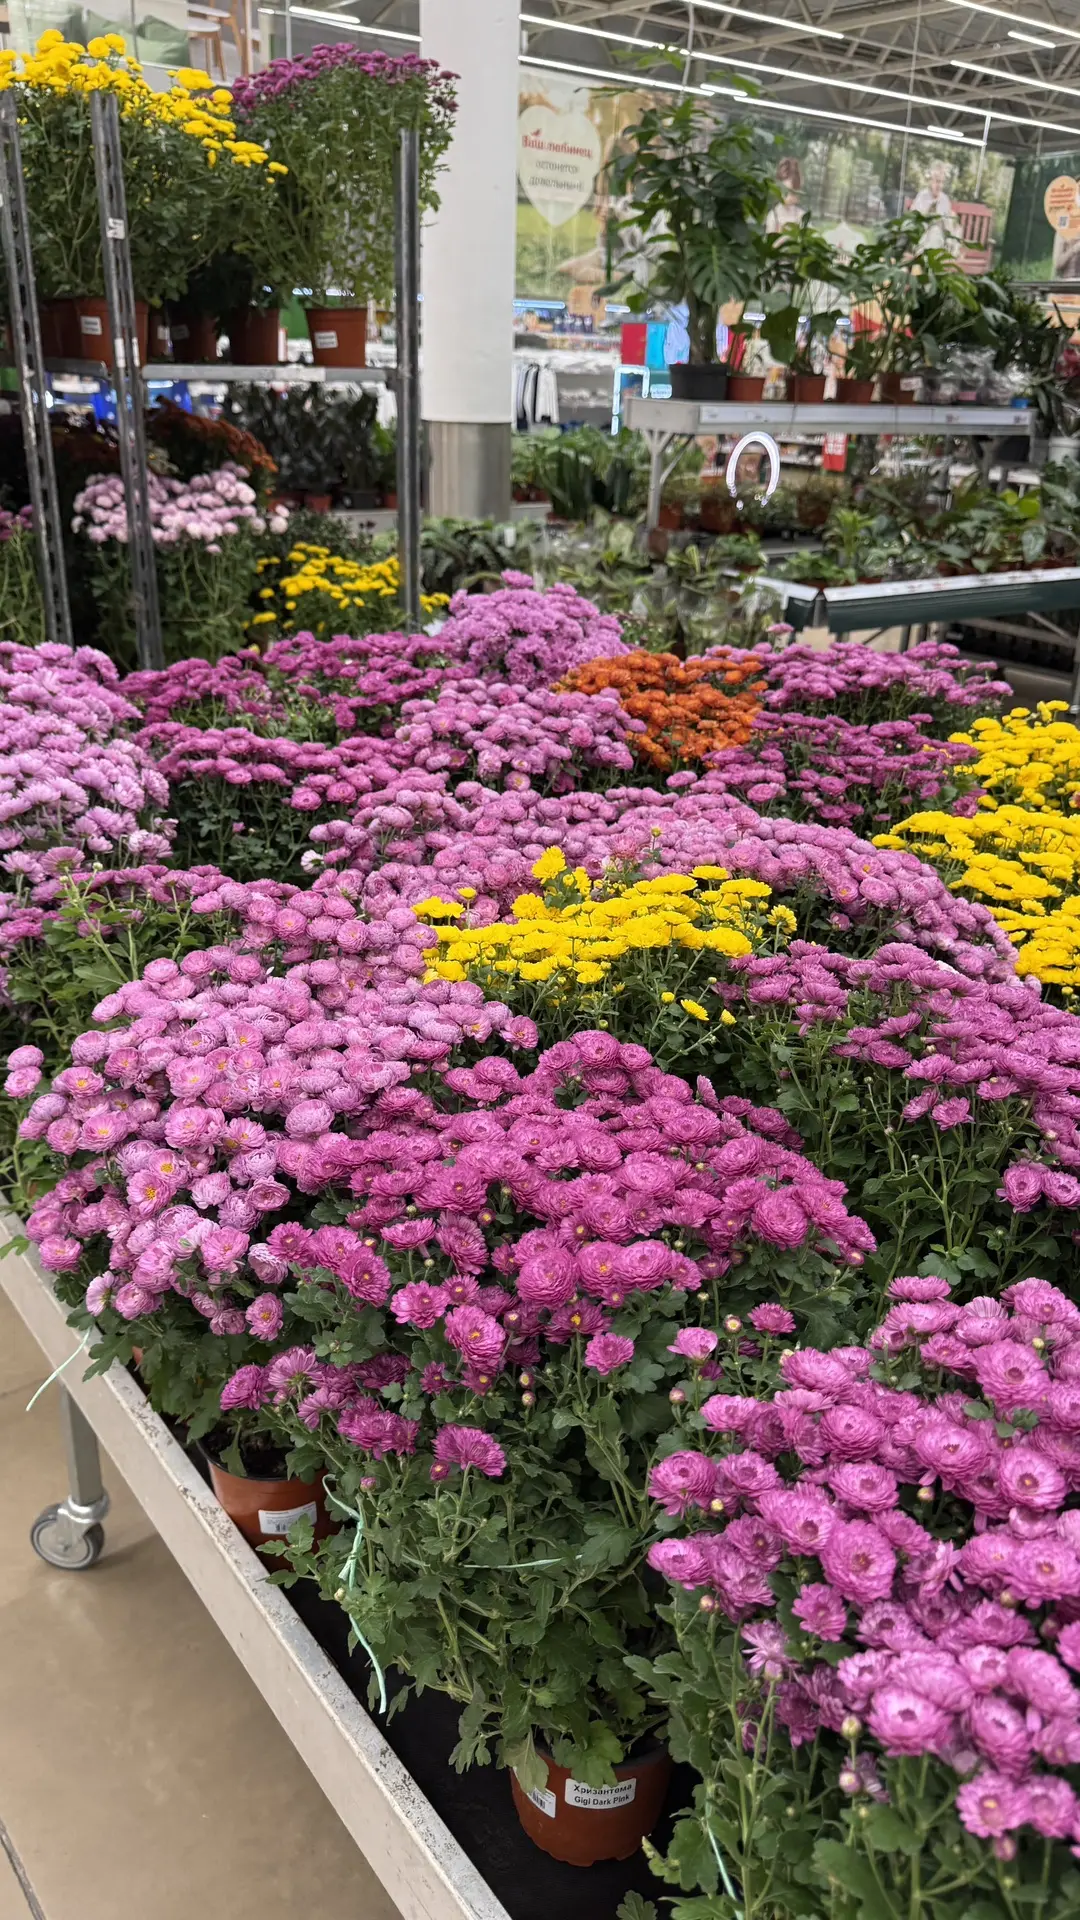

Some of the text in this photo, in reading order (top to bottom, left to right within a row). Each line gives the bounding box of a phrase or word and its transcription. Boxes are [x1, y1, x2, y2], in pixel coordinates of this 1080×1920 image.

[522, 135, 593, 160] Ваш любимец
[574, 1794, 630, 1806] Gigi Dark Pink
